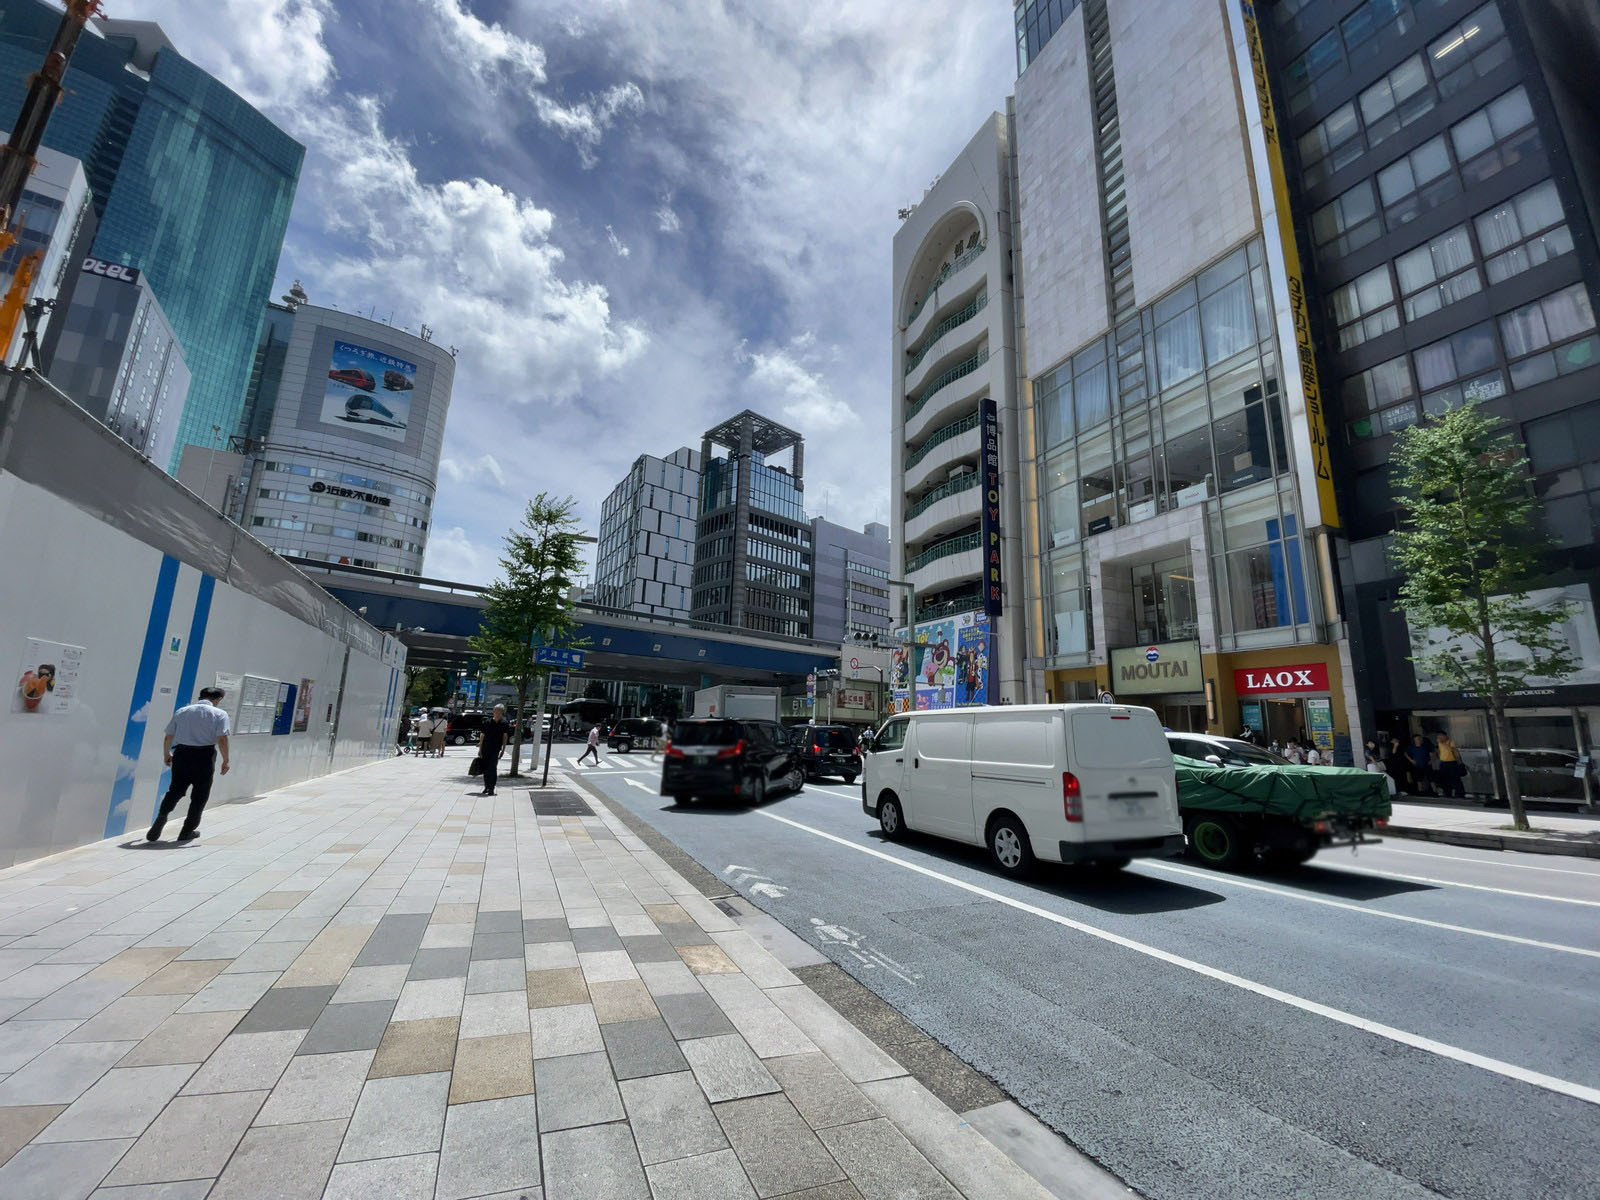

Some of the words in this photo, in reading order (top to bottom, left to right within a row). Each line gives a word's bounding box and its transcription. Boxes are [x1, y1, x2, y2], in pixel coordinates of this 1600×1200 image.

[986, 423, 998, 467] 博品館
[988, 472, 999, 521] TOY
[990, 532, 1000, 600] PARK
[1121, 660, 1189, 681] MOUTAI
[1245, 670, 1314, 688] LAOX
